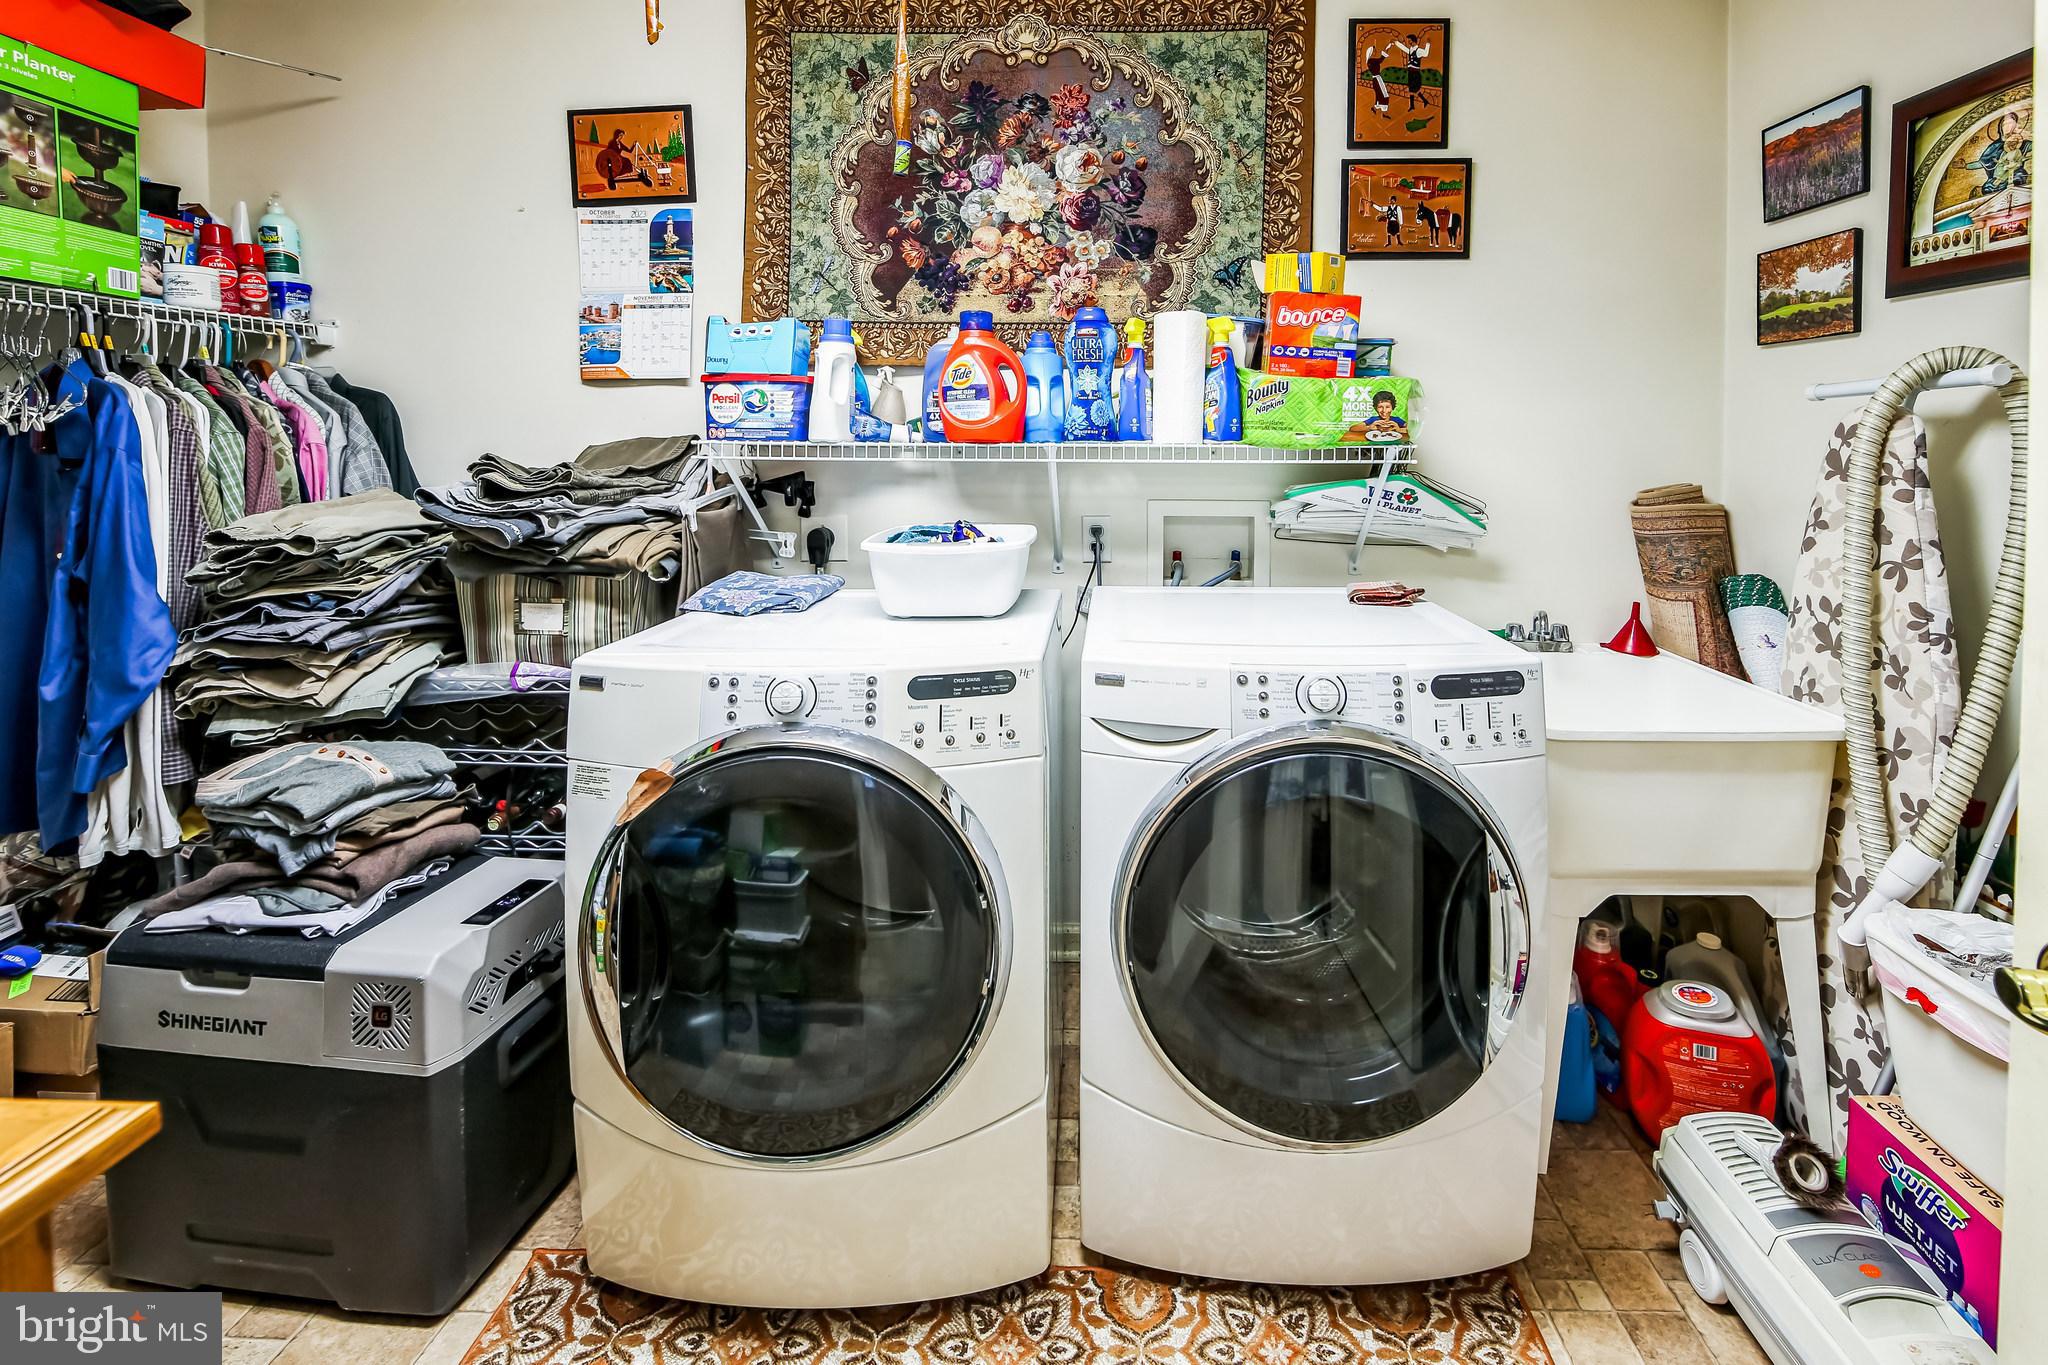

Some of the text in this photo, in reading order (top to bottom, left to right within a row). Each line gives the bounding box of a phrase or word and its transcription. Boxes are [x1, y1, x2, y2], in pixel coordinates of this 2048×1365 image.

[12, 49, 76, 83] Planter
[193, 217, 204, 226] 55
[1276, 306, 1347, 328] bounce
[1071, 338, 1103, 349] ULTRA
[707, 356, 729, 365] Downy
[1072, 349, 1104, 360] FRESH
[951, 368, 973, 383] Tide
[712, 392, 740, 404] Persil
[1246, 381, 1289, 409] Bounty
[1343, 386, 1372, 401] 4X
[1255, 399, 1285, 415] Napkins
[1343, 402, 1373, 411] MORE
[1383, 501, 1422, 515] PLANET
[158, 1009, 268, 1036] SHINEGIANT
[1877, 1102, 1928, 1143] WOOD
[1926, 1147, 1956, 1168] ON
[1878, 1147, 1965, 1231] Swiffer
[1955, 1172, 2004, 1209] SAFE
[1886, 1194, 1958, 1273] WETJET
[1812, 1252, 1882, 1266] LUX CLAS
